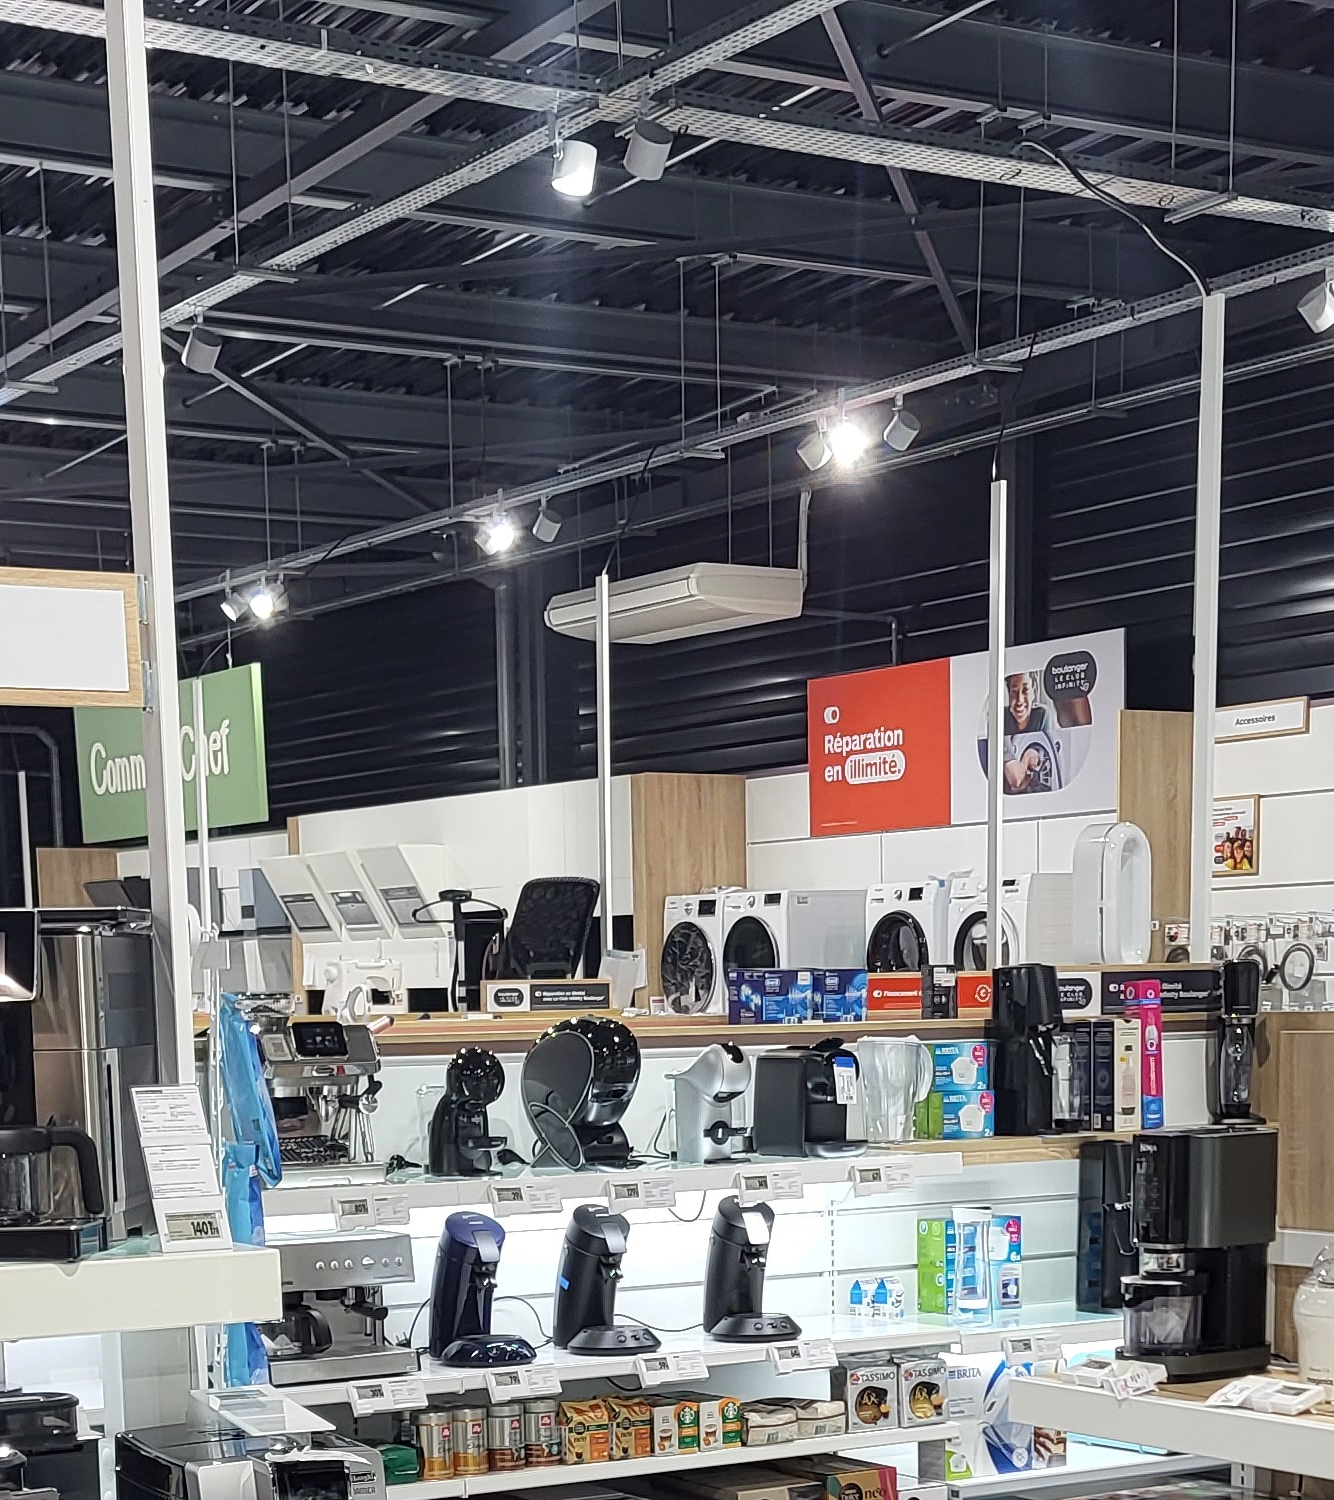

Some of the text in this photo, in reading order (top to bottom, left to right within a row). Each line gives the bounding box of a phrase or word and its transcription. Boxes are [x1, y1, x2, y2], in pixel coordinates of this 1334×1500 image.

[1051, 662, 1089, 675] boulanger
[1234, 714, 1276, 727] Accessoires
[824, 726, 904, 757] Réparation
[90, 718, 230, 795] Comm Chef
[824, 753, 902, 783] en illimité.
[860, 1371, 896, 1383] TASSIMO
[911, 1366, 947, 1378] TASSIMO
[956, 1367, 982, 1379] BRITA
